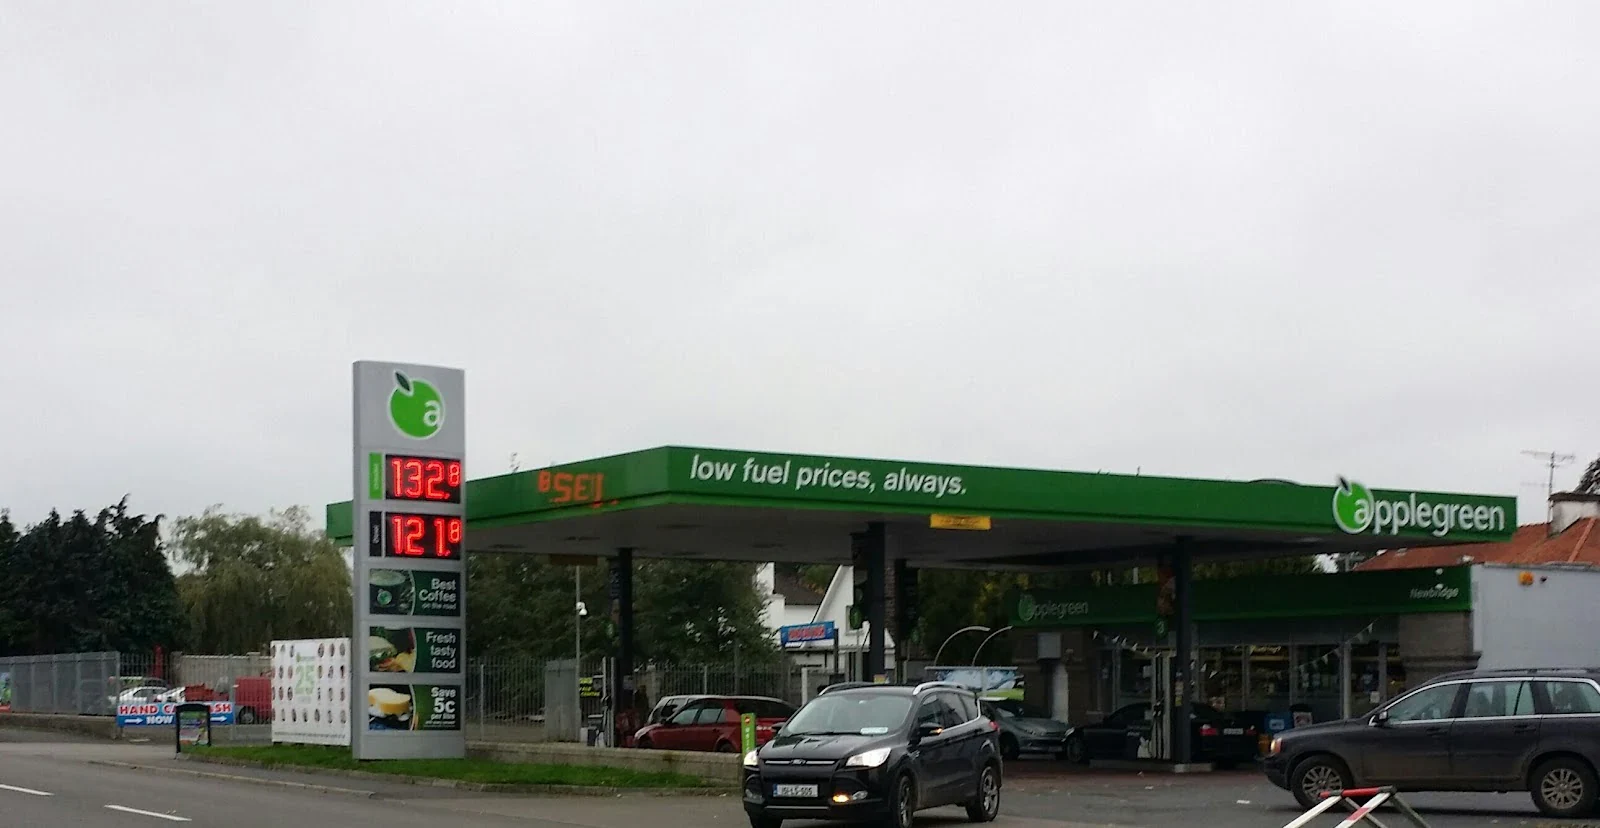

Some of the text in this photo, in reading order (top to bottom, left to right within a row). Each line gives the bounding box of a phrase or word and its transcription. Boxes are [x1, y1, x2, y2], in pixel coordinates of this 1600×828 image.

[690, 454, 967, 498] low fuel prices, always.
[1353, 493, 1506, 537] applegreen
[431, 577, 457, 591] Best
[418, 588, 457, 602] Coffee
[1409, 586, 1459, 600] Newbridge
[425, 631, 456, 644] Fresh
[430, 646, 456, 659] tasty
[431, 657, 456, 669] food
[430, 686, 457, 698] Save
[119, 705, 160, 715] HAND
[433, 697, 456, 713] 5c
[146, 715, 174, 725] NOW
